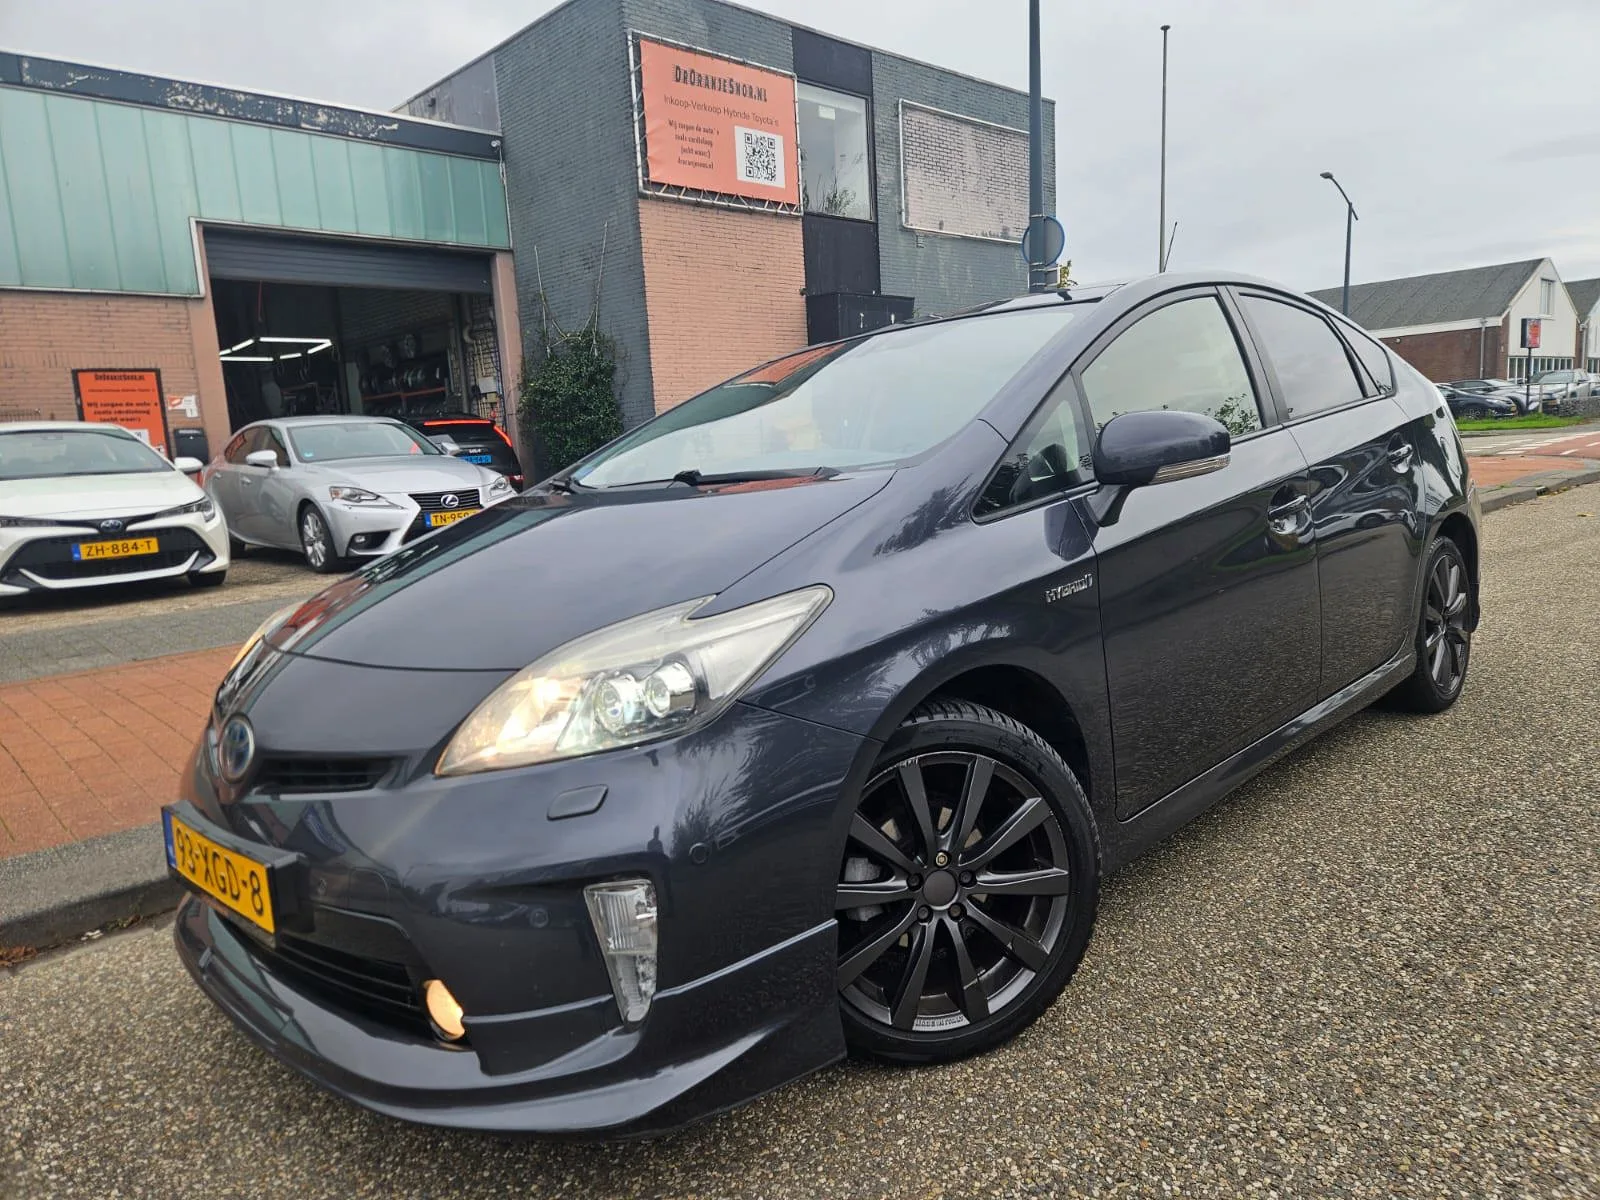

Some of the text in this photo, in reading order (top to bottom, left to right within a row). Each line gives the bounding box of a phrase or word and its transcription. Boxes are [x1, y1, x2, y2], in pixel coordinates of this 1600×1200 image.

[663, 94, 722, 116] Inkoop-Verkoop
[86, 540, 152, 557] ZH-884-T
[1045, 573, 1092, 603] HYBRID
[175, 826, 264, 917] 93-XGD-8
